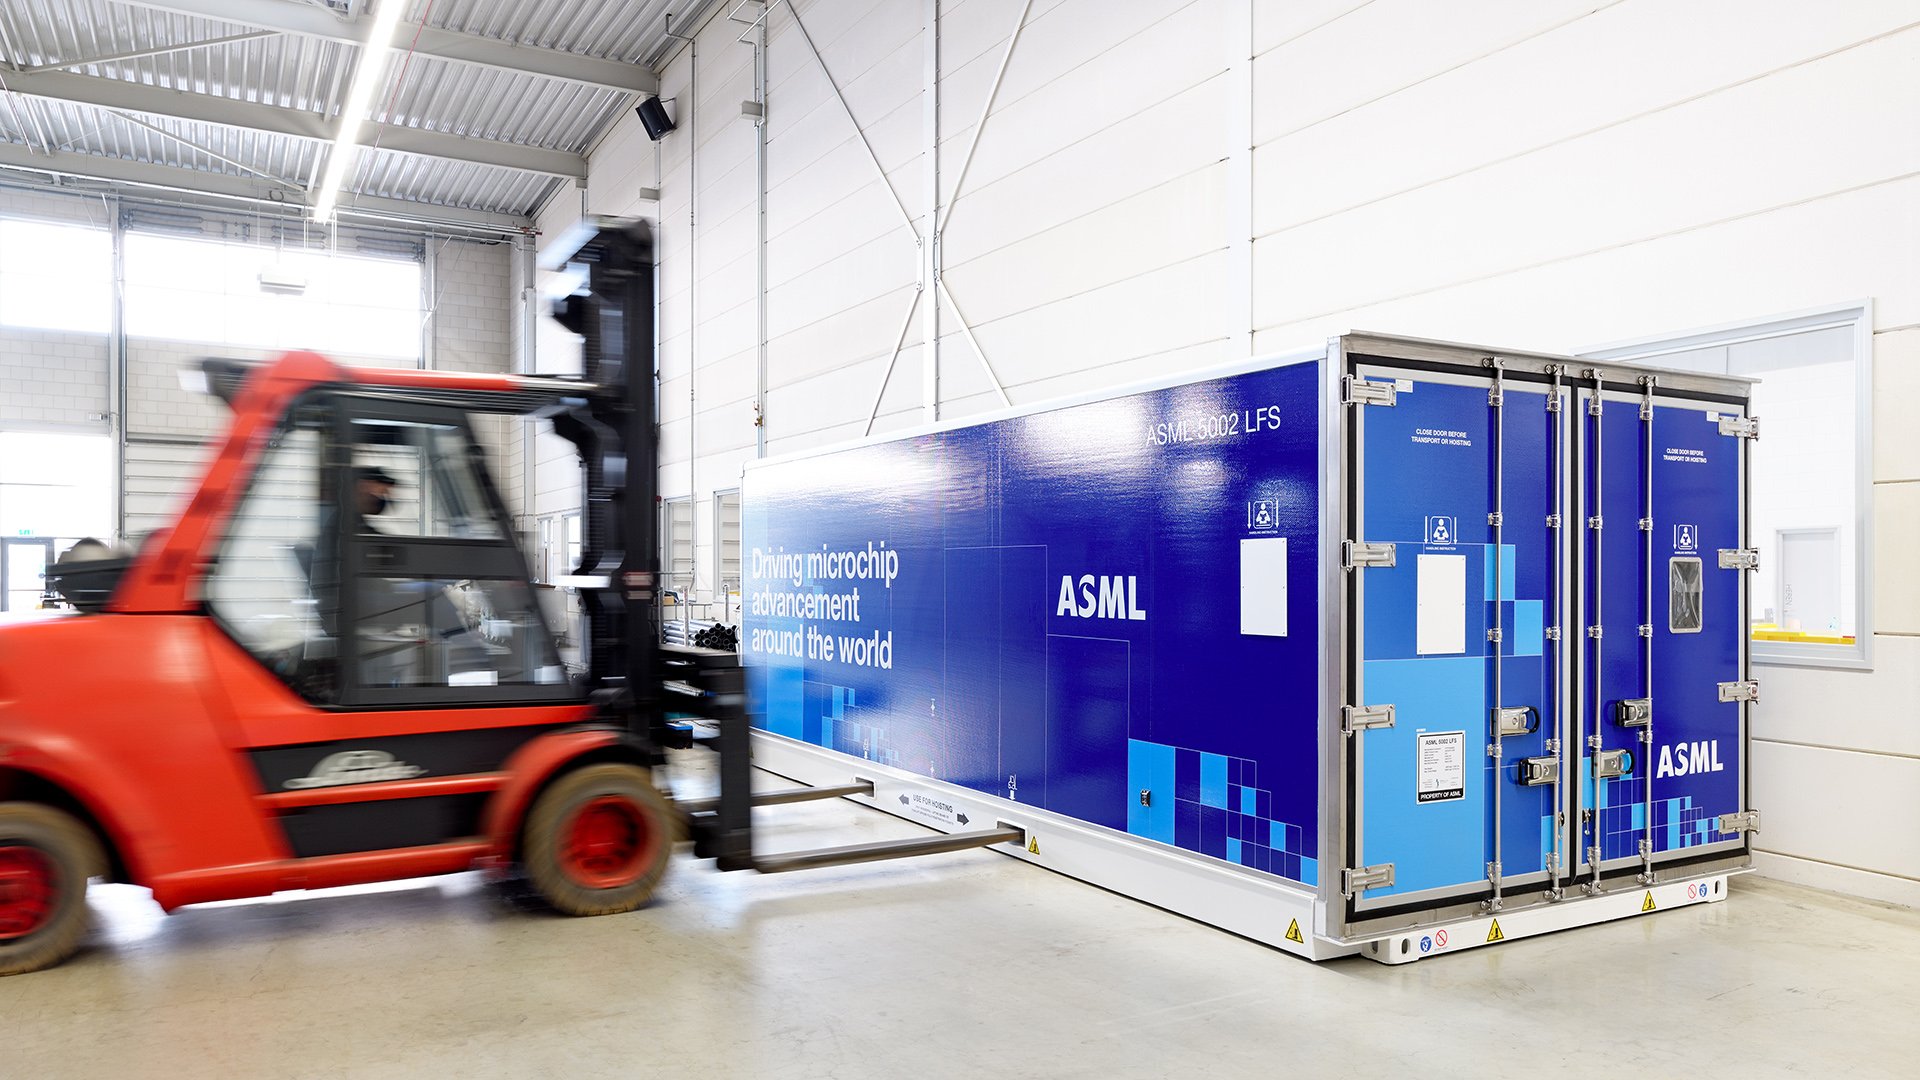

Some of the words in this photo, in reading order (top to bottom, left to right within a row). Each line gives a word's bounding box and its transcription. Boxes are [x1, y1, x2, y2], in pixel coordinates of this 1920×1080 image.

[1146, 421, 1193, 446] ASML
[1198, 413, 1239, 440] 5002
[1245, 405, 1281, 433] LFS
[1411, 436, 1441, 444] TRANSPORT
[1449, 439, 1472, 447] HOISTING
[1416, 428, 1433, 436] CLOSE
[1433, 429, 1447, 437] DOOR
[752, 546, 802, 587] Driving
[807, 541, 899, 588] microchip
[752, 585, 860, 622] advancement
[1056, 574, 1146, 621] ASML
[752, 624, 804, 658] around
[807, 625, 834, 662] the
[838, 630, 893, 669] world
[1656, 740, 1724, 779] ASML
[913, 795, 922, 803] USE
[922, 797, 931, 805] FOR
[931, 800, 953, 813] HOISTING
[1420, 792, 1443, 800] PROPERTY
